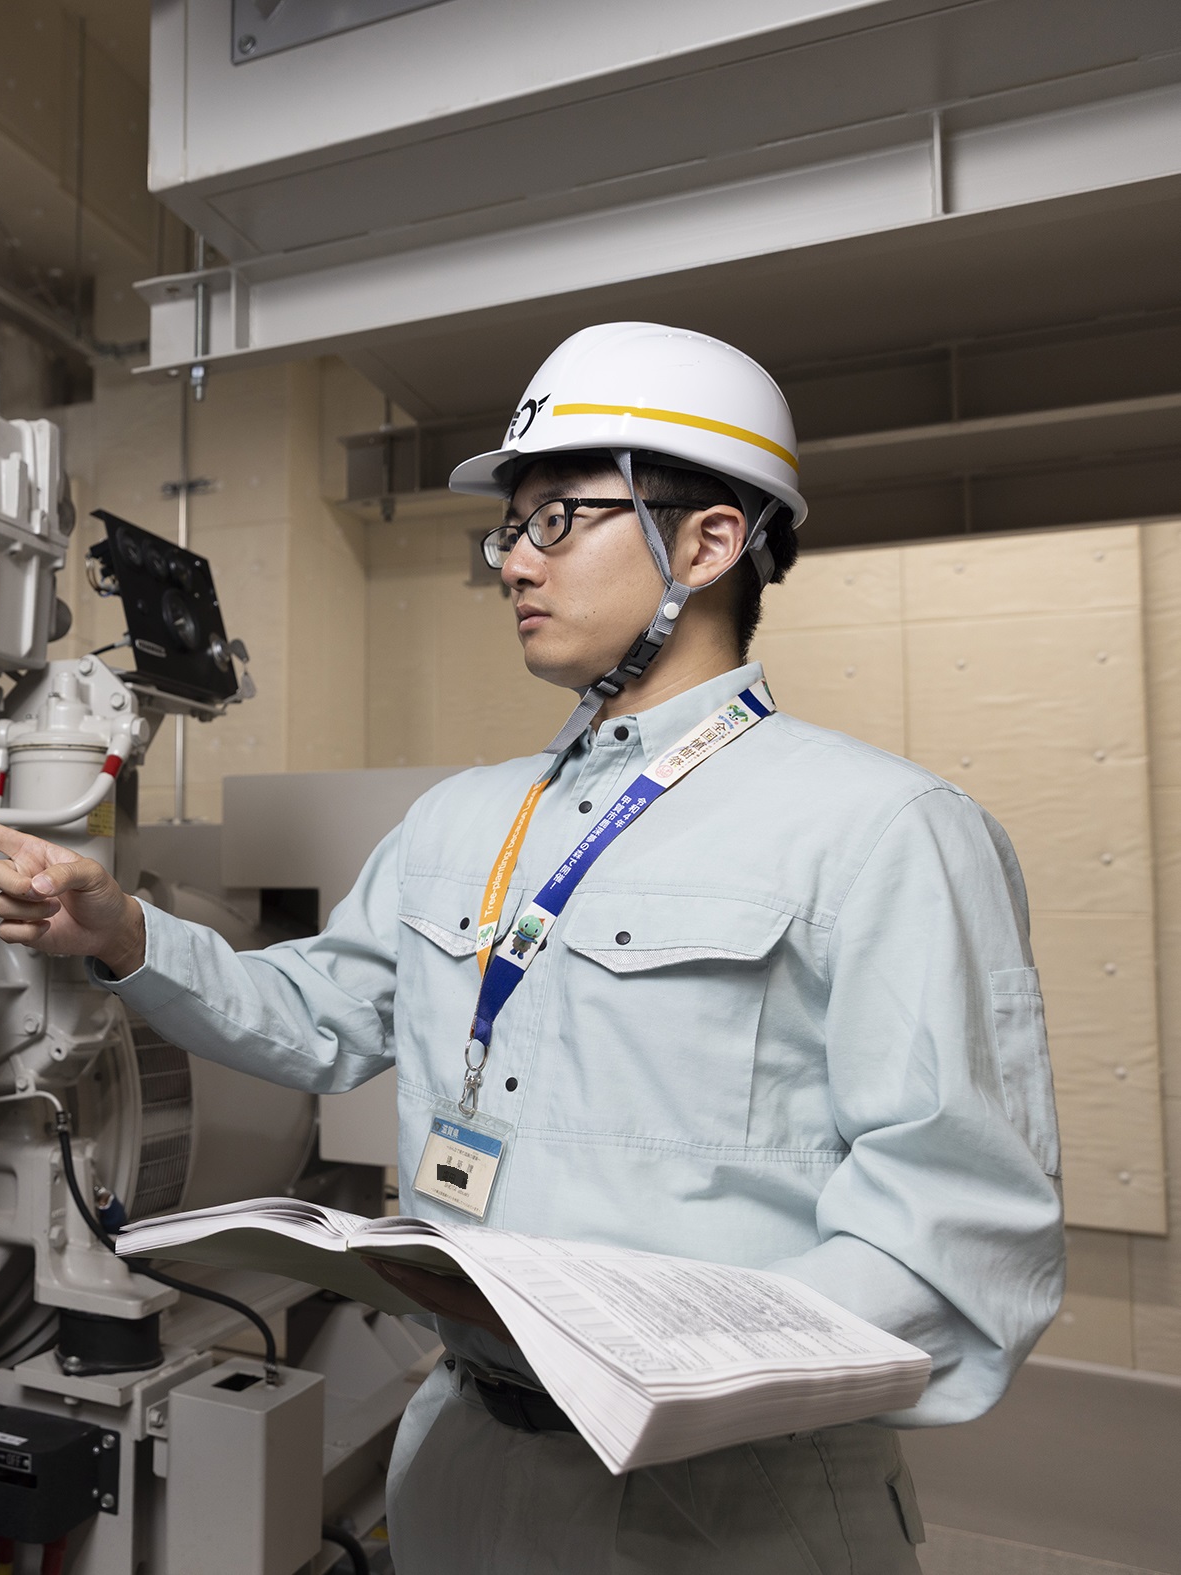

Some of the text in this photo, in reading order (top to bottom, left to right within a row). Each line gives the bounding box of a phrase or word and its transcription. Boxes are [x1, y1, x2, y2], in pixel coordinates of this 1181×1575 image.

[667, 721, 726, 767] 全国植樹祭
[506, 810, 527, 849] because
[523, 789, 538, 812] Lake
[614, 797, 647, 828] 令和4年
[441, 1123, 459, 1139] 滋賀県
